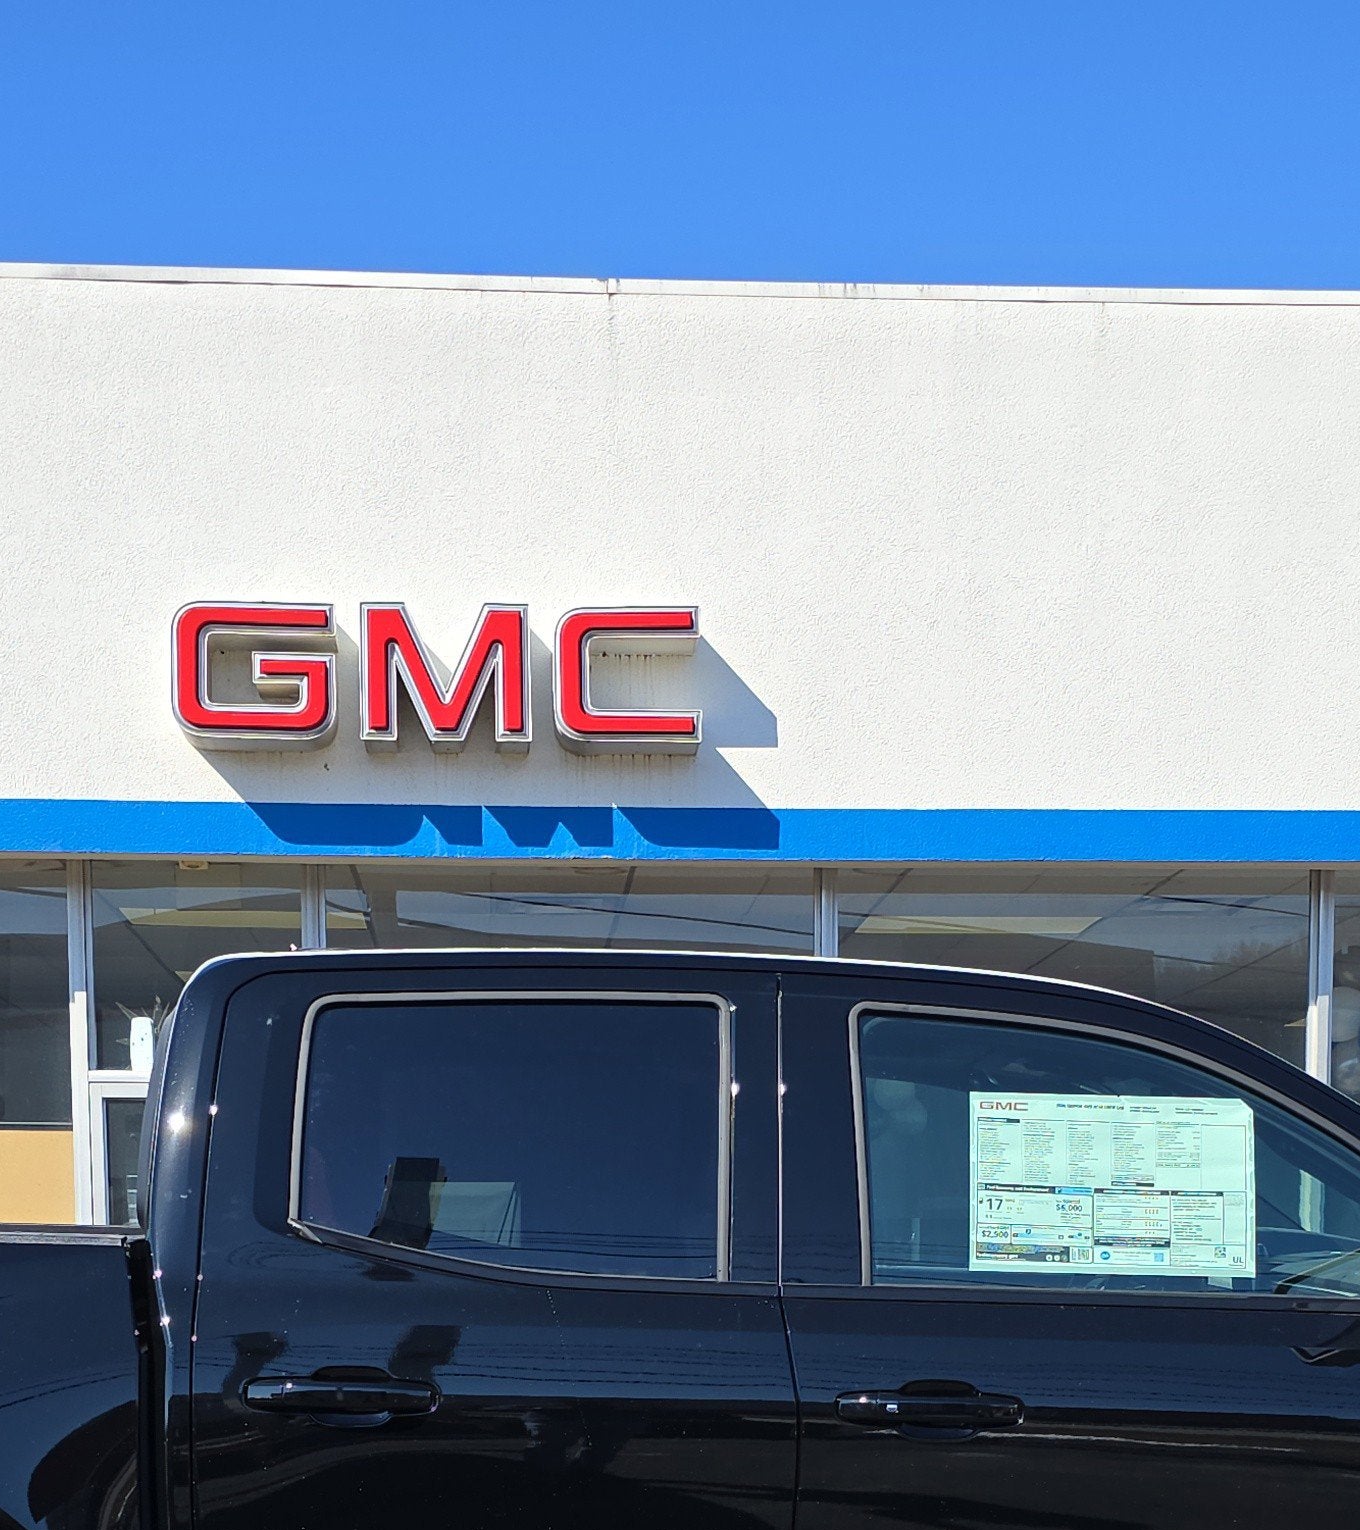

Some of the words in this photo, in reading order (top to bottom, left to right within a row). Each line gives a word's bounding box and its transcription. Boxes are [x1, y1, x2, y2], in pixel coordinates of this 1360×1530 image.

[171, 601, 702, 748] GMC
[980, 1101, 1028, 1111] GMC
[986, 1198, 1003, 1210] 17
